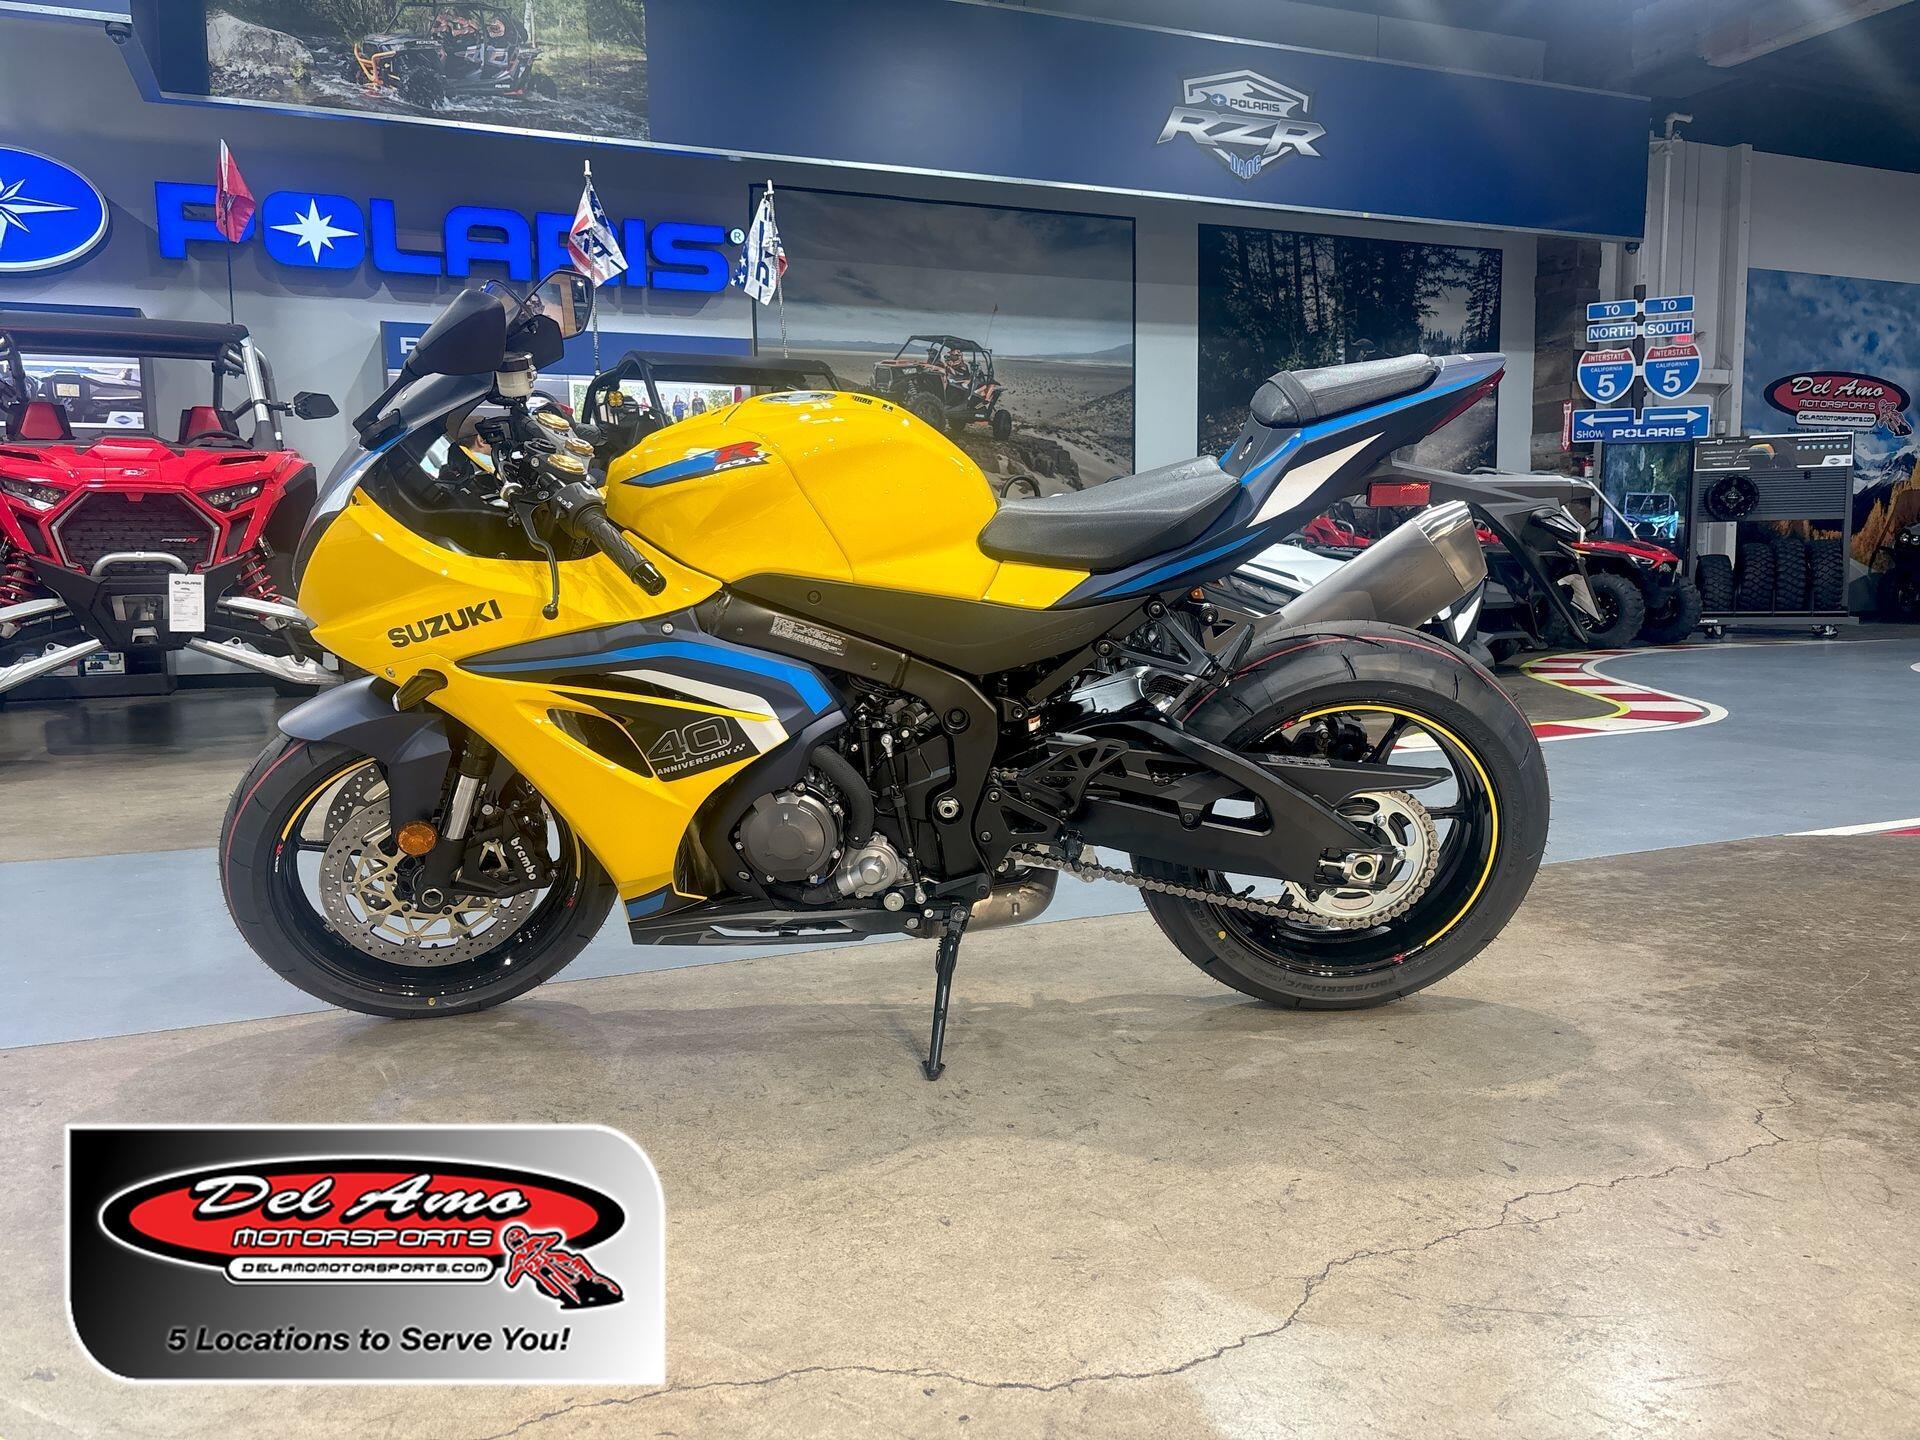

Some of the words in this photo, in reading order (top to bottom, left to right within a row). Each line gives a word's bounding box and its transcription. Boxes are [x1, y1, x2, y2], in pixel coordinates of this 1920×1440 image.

[1229, 98, 1281, 112] POLARIS
[1156, 106, 1327, 157] RZR
[1604, 305, 1621, 316] TO
[1660, 300, 1678, 311] TO
[1590, 326, 1634, 339] NORTH
[1647, 321, 1690, 334] SOUTH
[1588, 354, 1625, 362] INTERSTATE
[1653, 348, 1691, 357] INTERSTATE
[1655, 361, 1689, 369] CALIFORNIA
[1597, 374, 1616, 397] 5
[1662, 369, 1681, 393] 5
[1791, 376, 1832, 394] Del
[1834, 379, 1884, 396] Amo
[1799, 400, 1876, 410] MOTORSPORTS
[1612, 427, 1686, 438] POLARIS
[387, 599, 503, 648] SUZUKI
[657, 748, 732, 775] ANNIVERSARY
[510, 836, 536, 880] brembo
